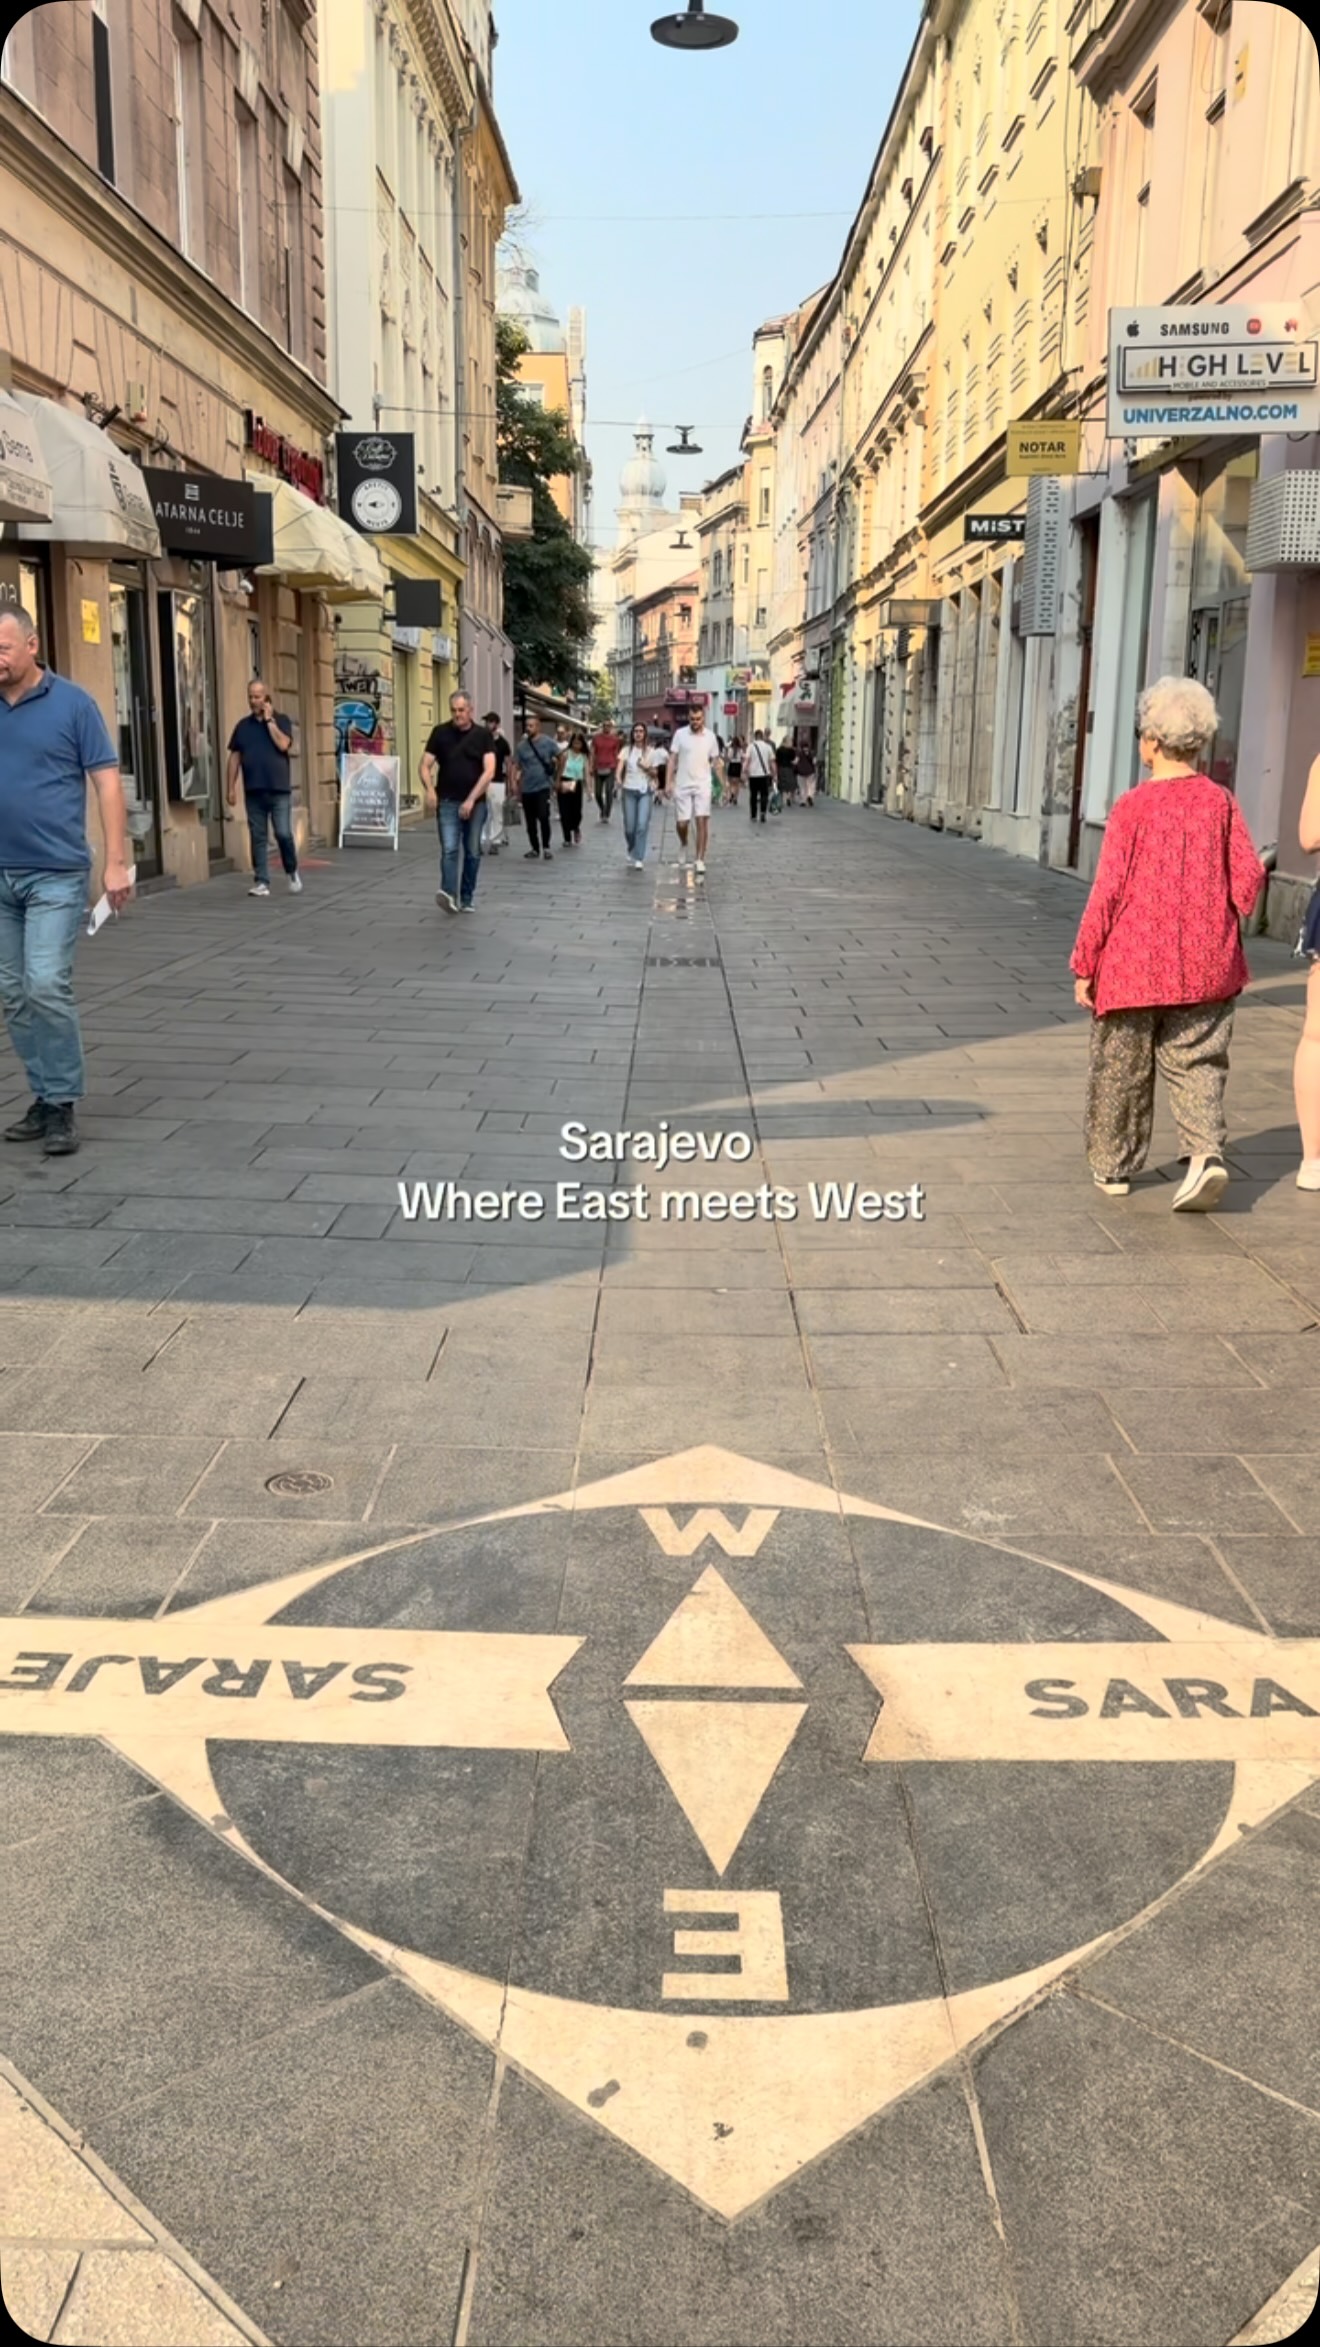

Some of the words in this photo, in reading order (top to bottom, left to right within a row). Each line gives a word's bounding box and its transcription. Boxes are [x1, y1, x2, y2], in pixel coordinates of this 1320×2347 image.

[1160, 322, 1229, 336] SAMSUNG
[1158, 354, 1227, 378] HIGH
[1238, 351, 1311, 375] LEVEL
[1173, 380, 1200, 390] MOBILE
[1202, 380, 1218, 389] AND
[1219, 378, 1267, 388] ACCESSORIES
[1123, 404, 1298, 425] UNIVERZALNO.COM
[1019, 441, 1066, 453] NOTAR
[208, 508, 245, 529] CELJE
[637, 1508, 781, 1557] W
[1024, 1678, 1320, 1719] SARA
[662, 1888, 789, 2000] E
